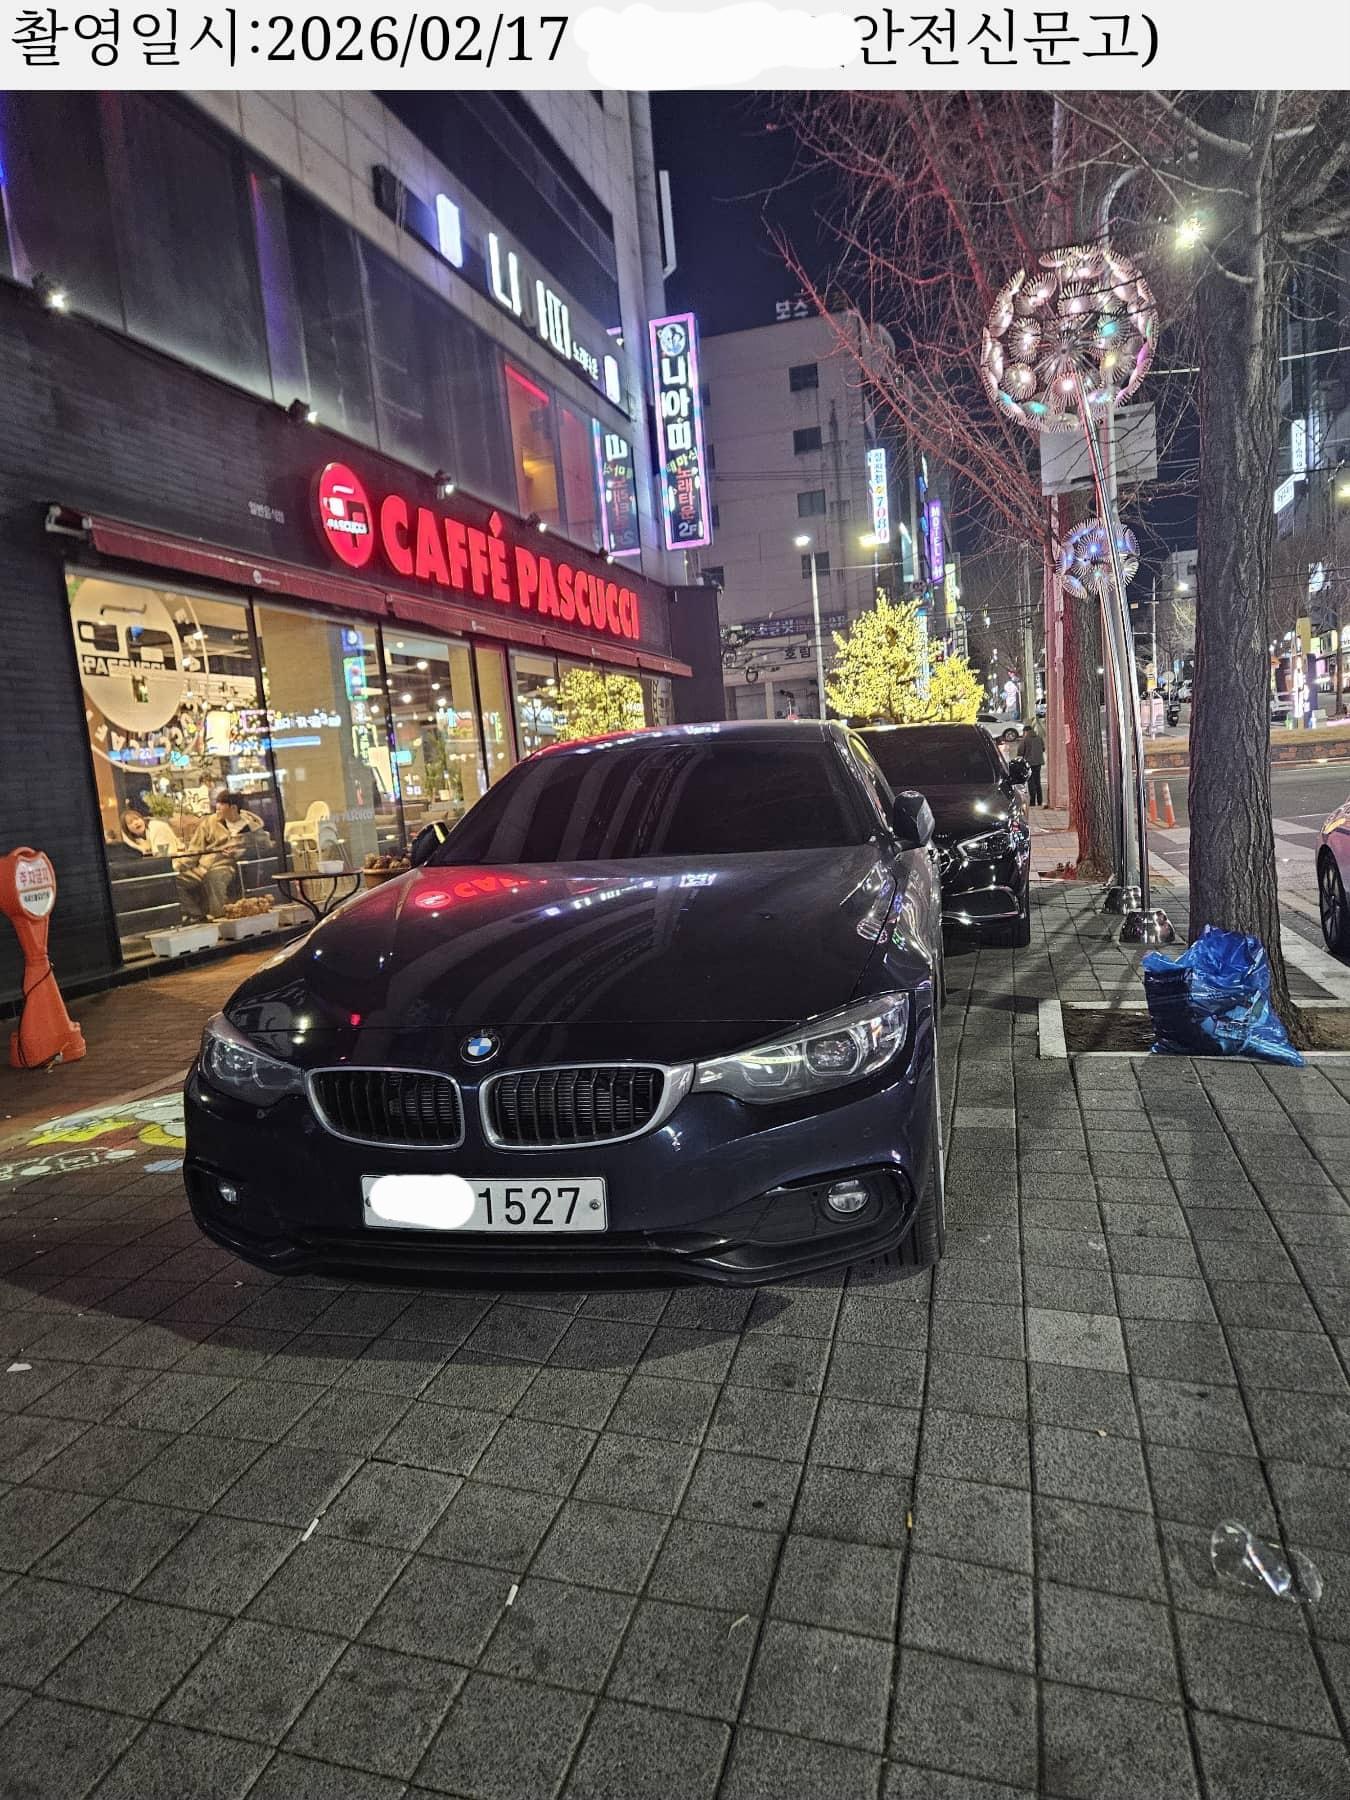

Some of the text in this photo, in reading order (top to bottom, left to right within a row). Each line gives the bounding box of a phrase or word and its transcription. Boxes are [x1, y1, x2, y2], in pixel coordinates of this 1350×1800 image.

[679, 522, 697, 537] 2F
[515, 546, 640, 640] PASCUCCI
[478, 1187, 580, 1225] 1527
